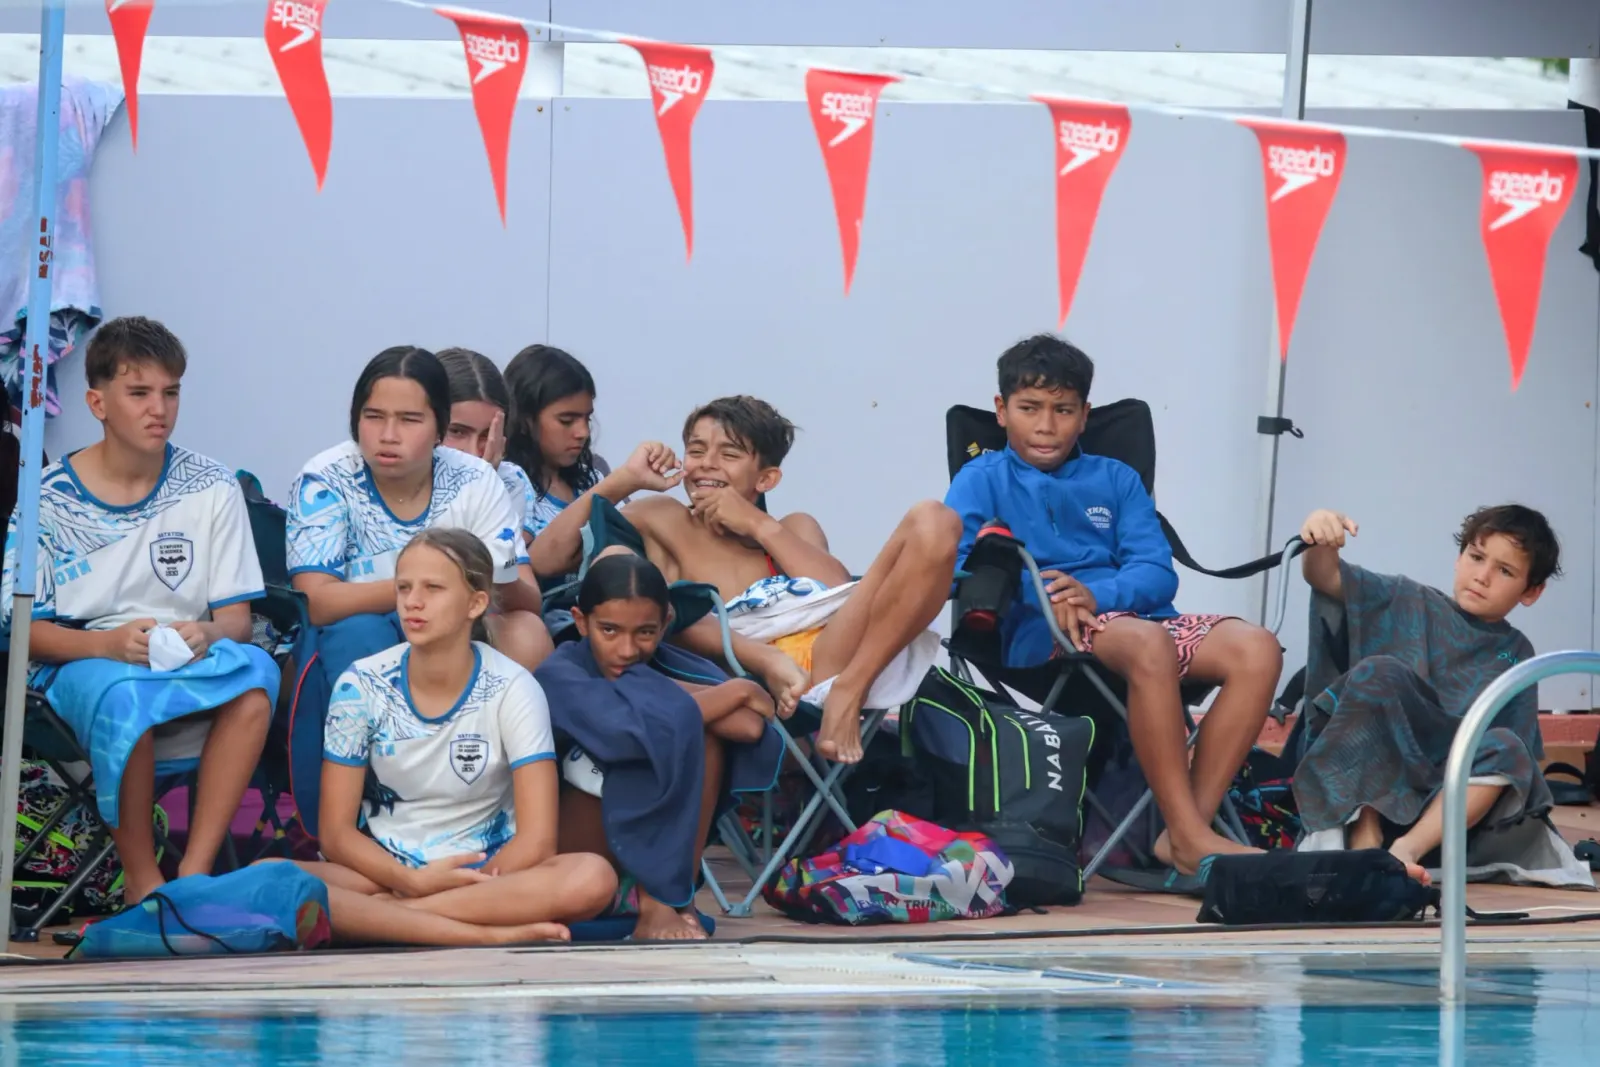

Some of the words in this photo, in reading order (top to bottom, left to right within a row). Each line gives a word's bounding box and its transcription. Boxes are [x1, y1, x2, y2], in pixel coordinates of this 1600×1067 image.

[465, 32, 520, 64] speedo
[648, 64, 702, 95] speedo
[1059, 119, 1119, 152] speedo
[1267, 145, 1335, 177] speedo
[1488, 169, 1563, 202] speedo
